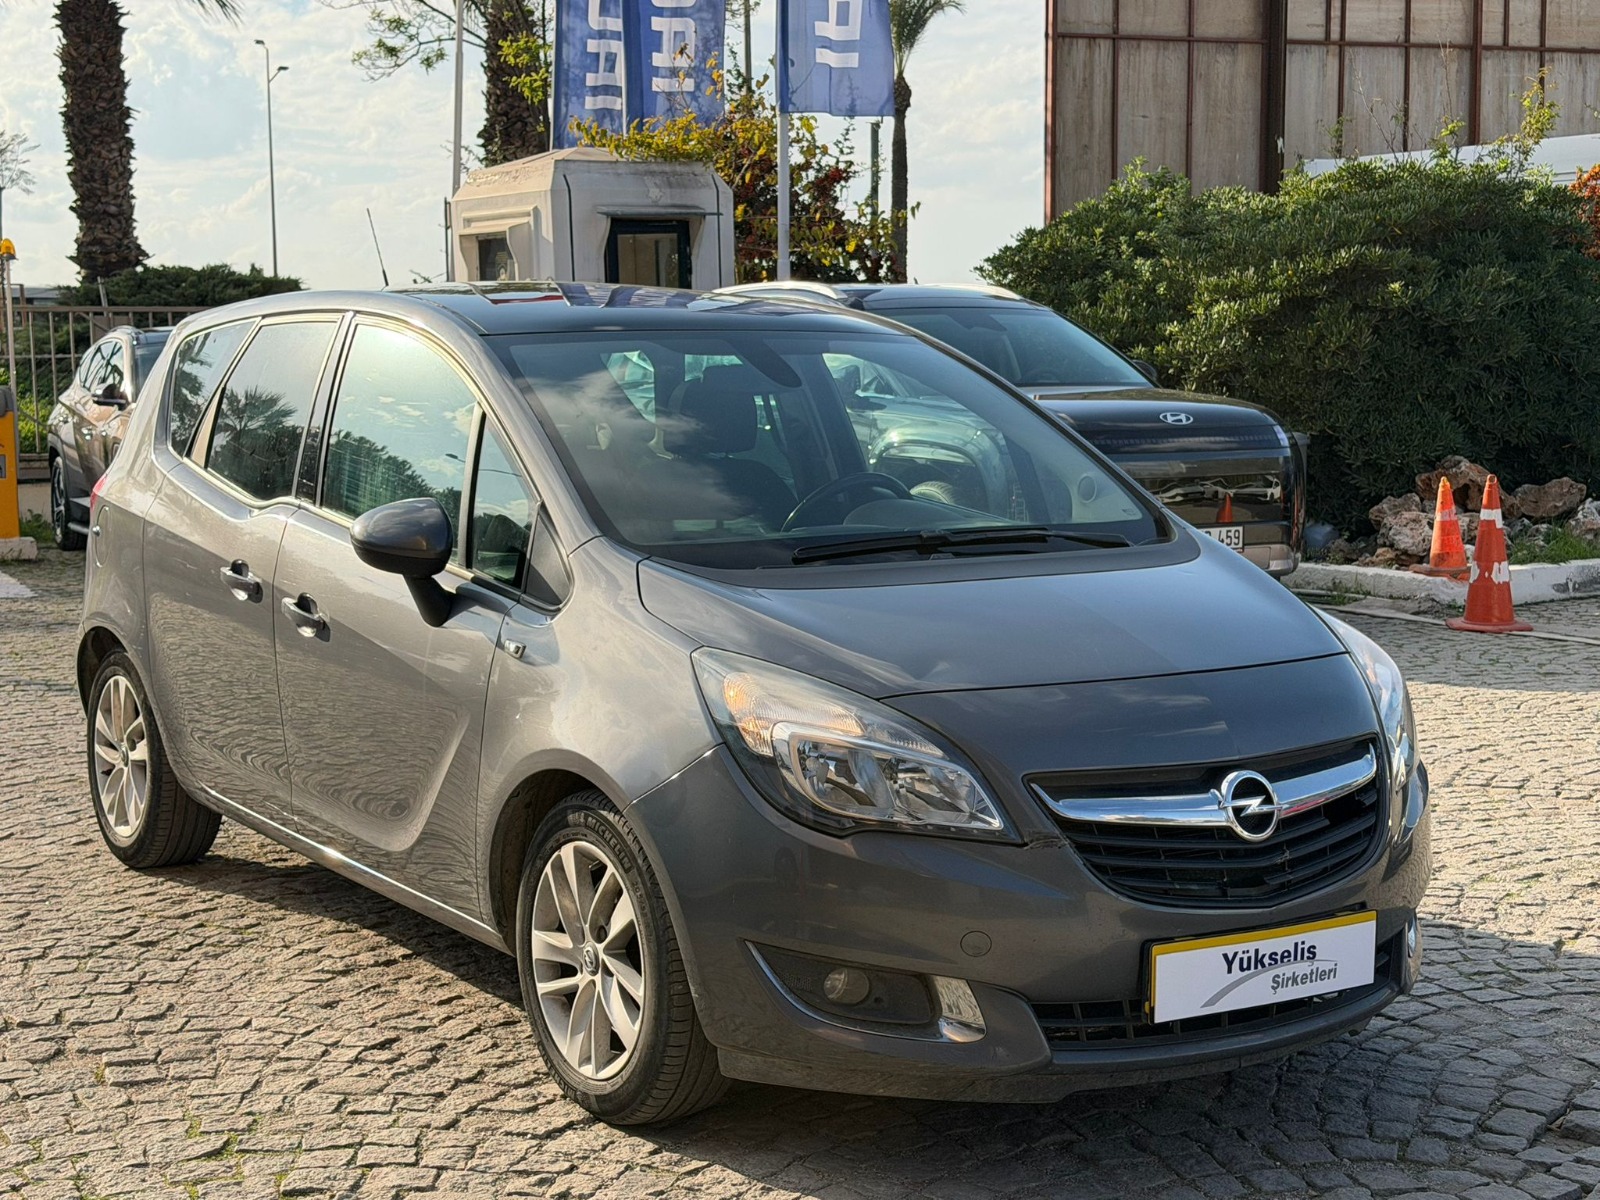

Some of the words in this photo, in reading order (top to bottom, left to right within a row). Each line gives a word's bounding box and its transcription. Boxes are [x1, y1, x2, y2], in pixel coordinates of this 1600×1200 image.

[651, 0, 695, 92] AI
[586, 816, 631, 870] MICHELIN
[1222, 940, 1317, 974] Yükseliş
[1271, 963, 1338, 994] Şirketleri
